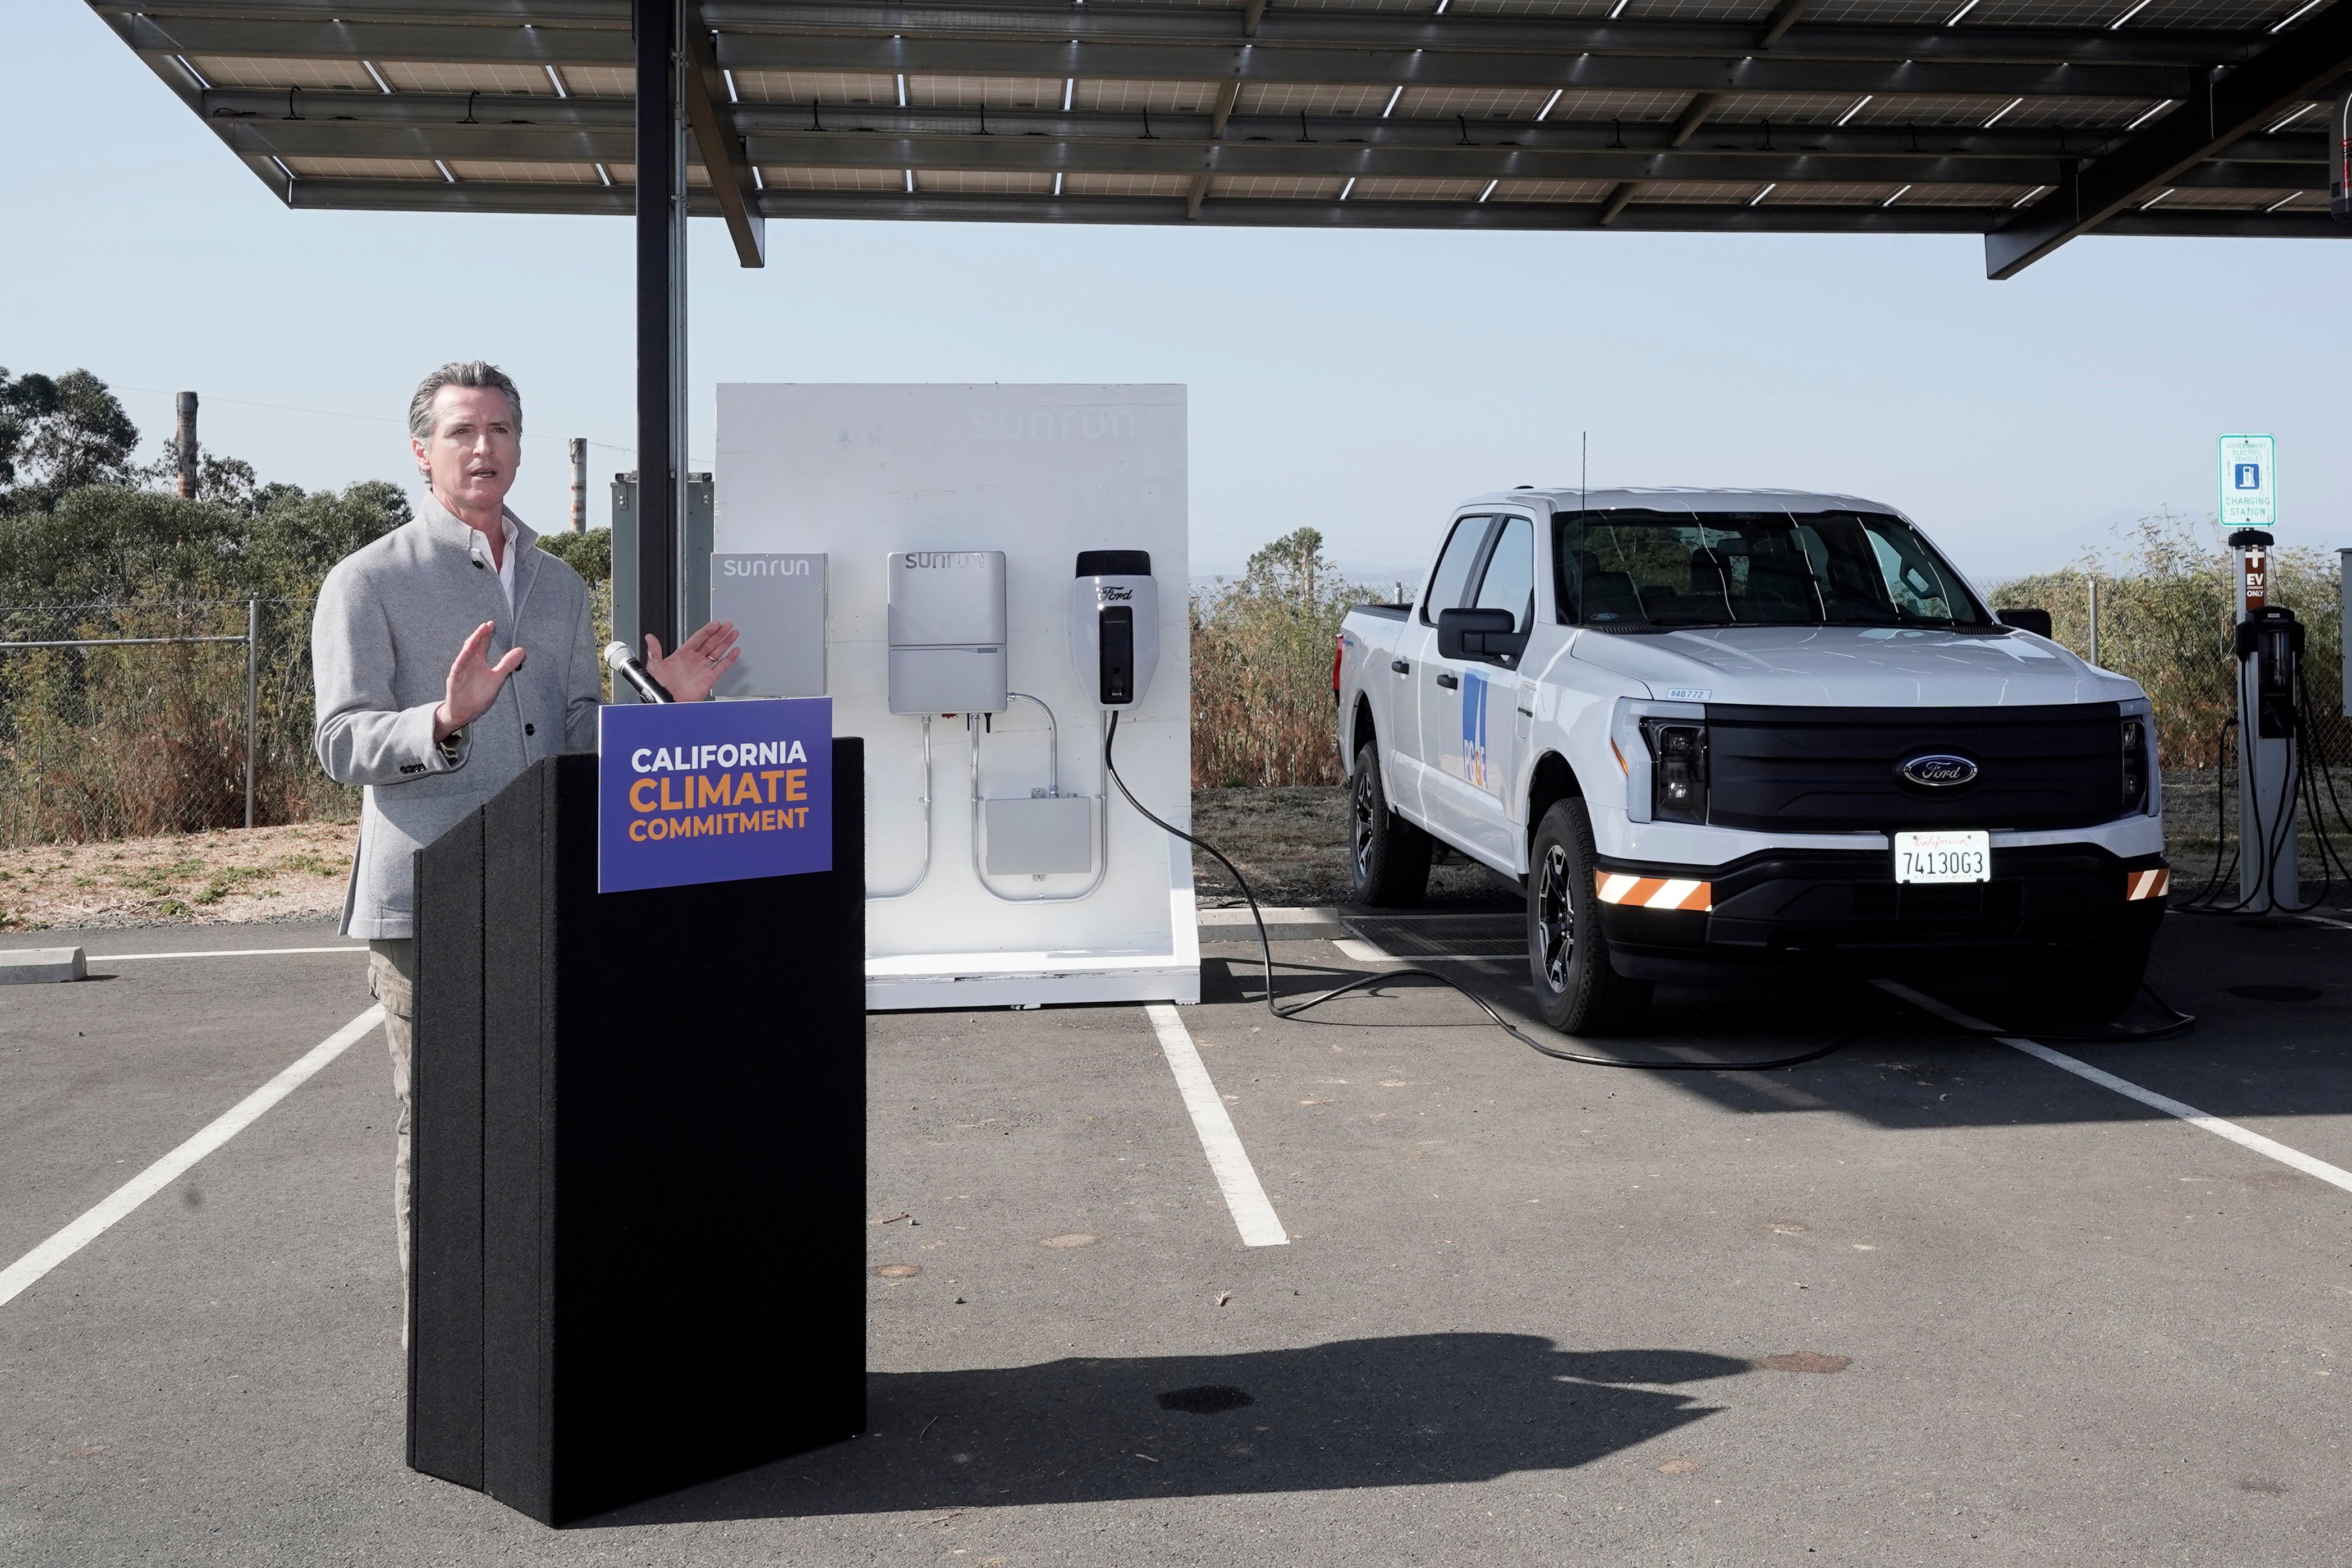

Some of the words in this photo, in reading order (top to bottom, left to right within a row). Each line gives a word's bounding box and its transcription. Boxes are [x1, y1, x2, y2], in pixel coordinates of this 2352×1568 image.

[970, 409, 1136, 440] sunrun
[723, 560, 809, 576] sunrun
[905, 552, 984, 569] sunrun
[2246, 573, 2264, 585] EV
[1098, 586, 1133, 602] Ford
[631, 740, 808, 773] CALIFORNIA
[1464, 739, 1488, 790] PG&E
[1922, 762, 1961, 779] Ford
[629, 768, 808, 813] CLIMATE
[629, 807, 809, 842] COMMITMENT
[1915, 835, 1971, 849] California
[1903, 852, 1983, 874] 74130G3
